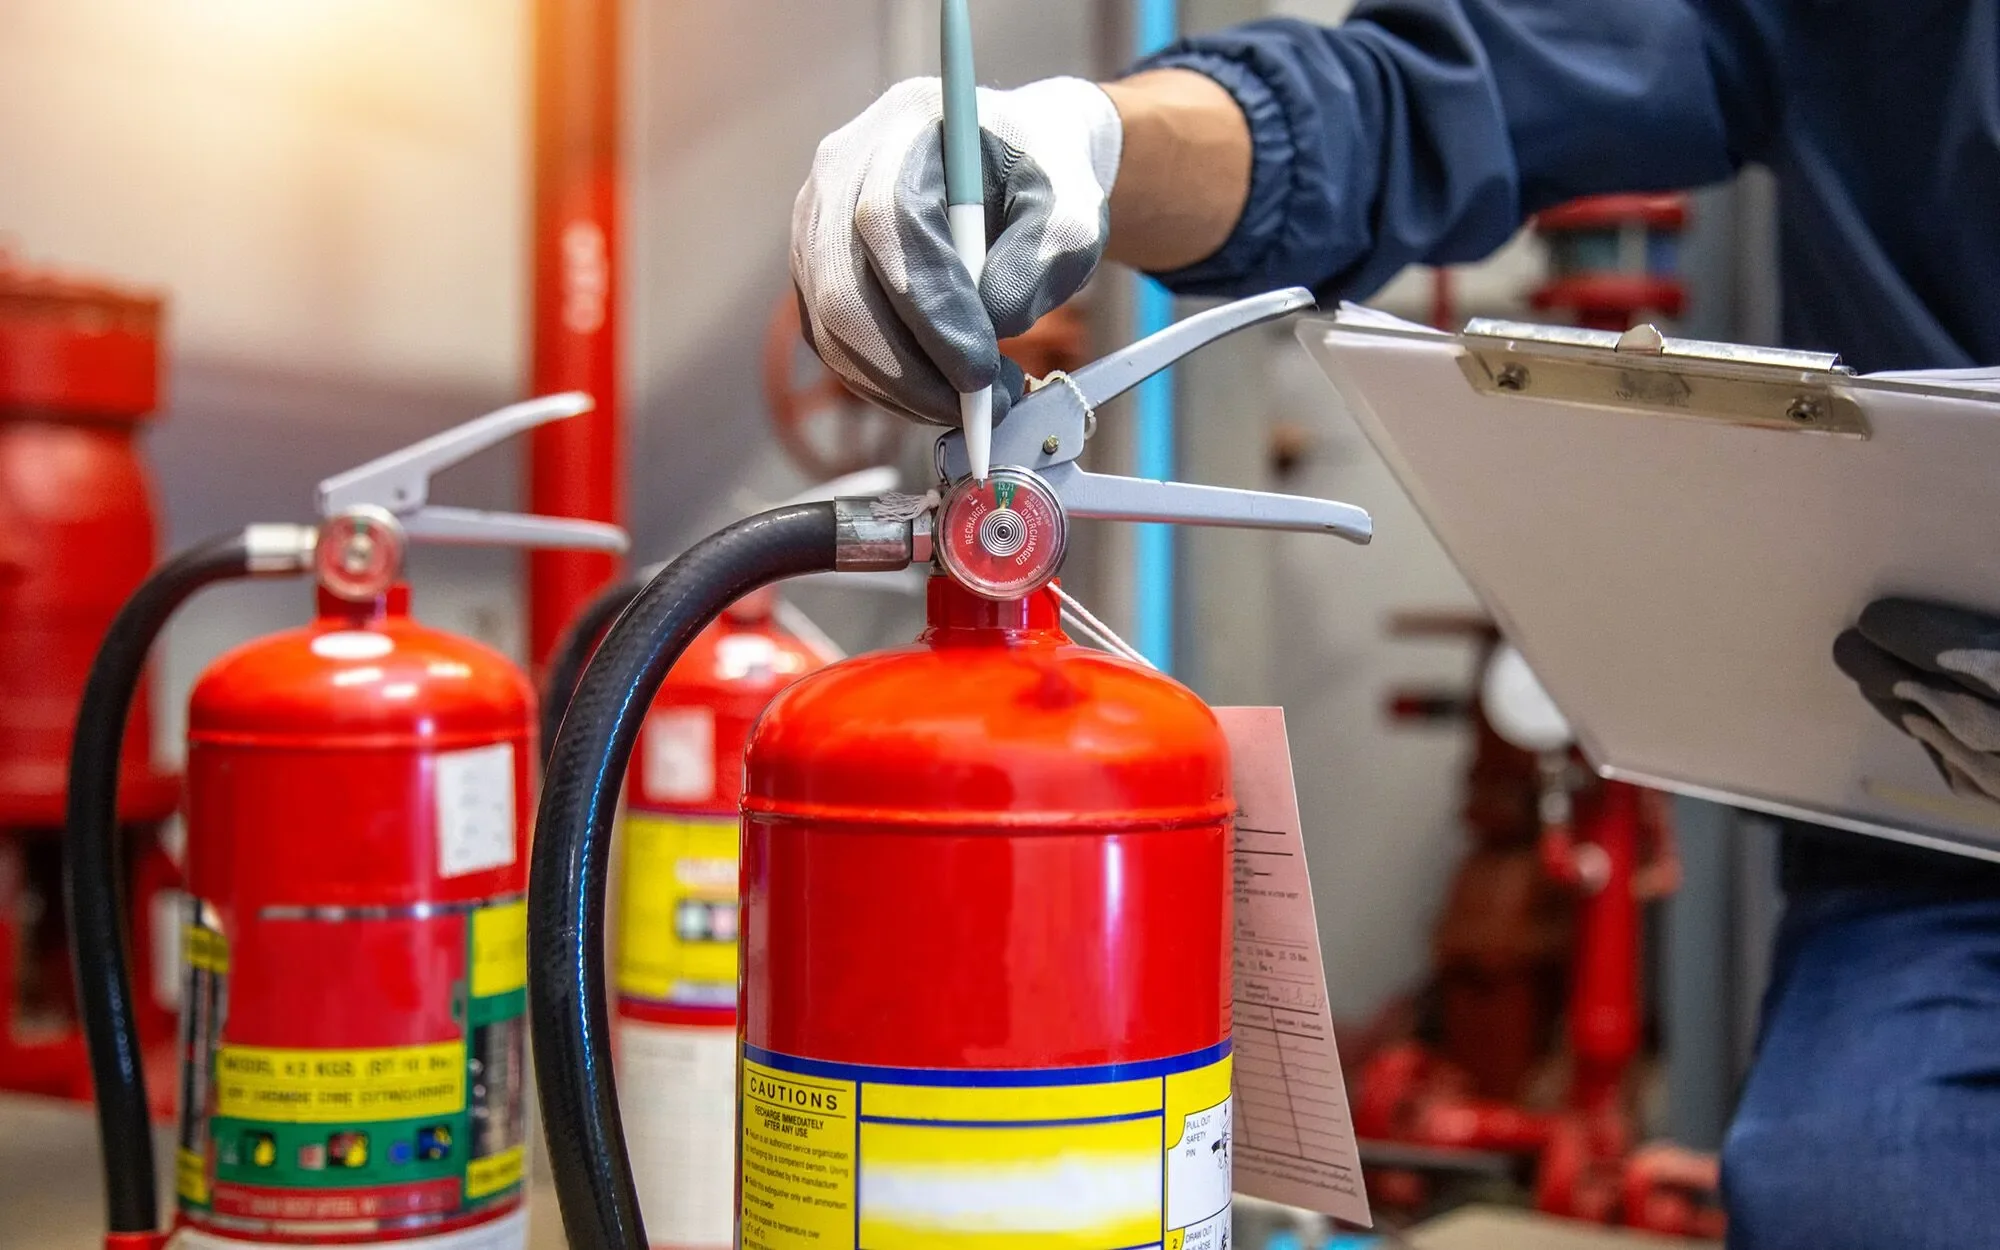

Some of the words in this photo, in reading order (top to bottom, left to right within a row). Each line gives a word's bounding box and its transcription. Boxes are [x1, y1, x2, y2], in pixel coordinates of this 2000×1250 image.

[965, 504, 988, 545] RECHARGE
[1016, 508, 1038, 566] OVERCHARGED
[750, 1078, 838, 1110] CAUTIONS
[754, 1104, 780, 1120] RECHARGE
[782, 1114, 824, 1130] IMMEDIATELY
[1186, 1120, 1200, 1130] PULL
[1200, 1114, 1211, 1126] OUT
[764, 1119, 780, 1132] AFTER
[782, 1124, 794, 1134] ANY
[794, 1127, 808, 1138] USE
[1186, 1130, 1206, 1144] SAFETY
[793, 1144, 811, 1154] service
[812, 1148, 848, 1160] organization
[1186, 1148, 1196, 1158] PIN
[778, 1156, 805, 1168] competent
[792, 1174, 800, 1182] the
[790, 1192, 801, 1204] only
[803, 1196, 813, 1204] with
[1186, 1231, 1201, 1244] DRAW
[1202, 1225, 1212, 1237] OUT
[1172, 1238, 1178, 1249] 2
